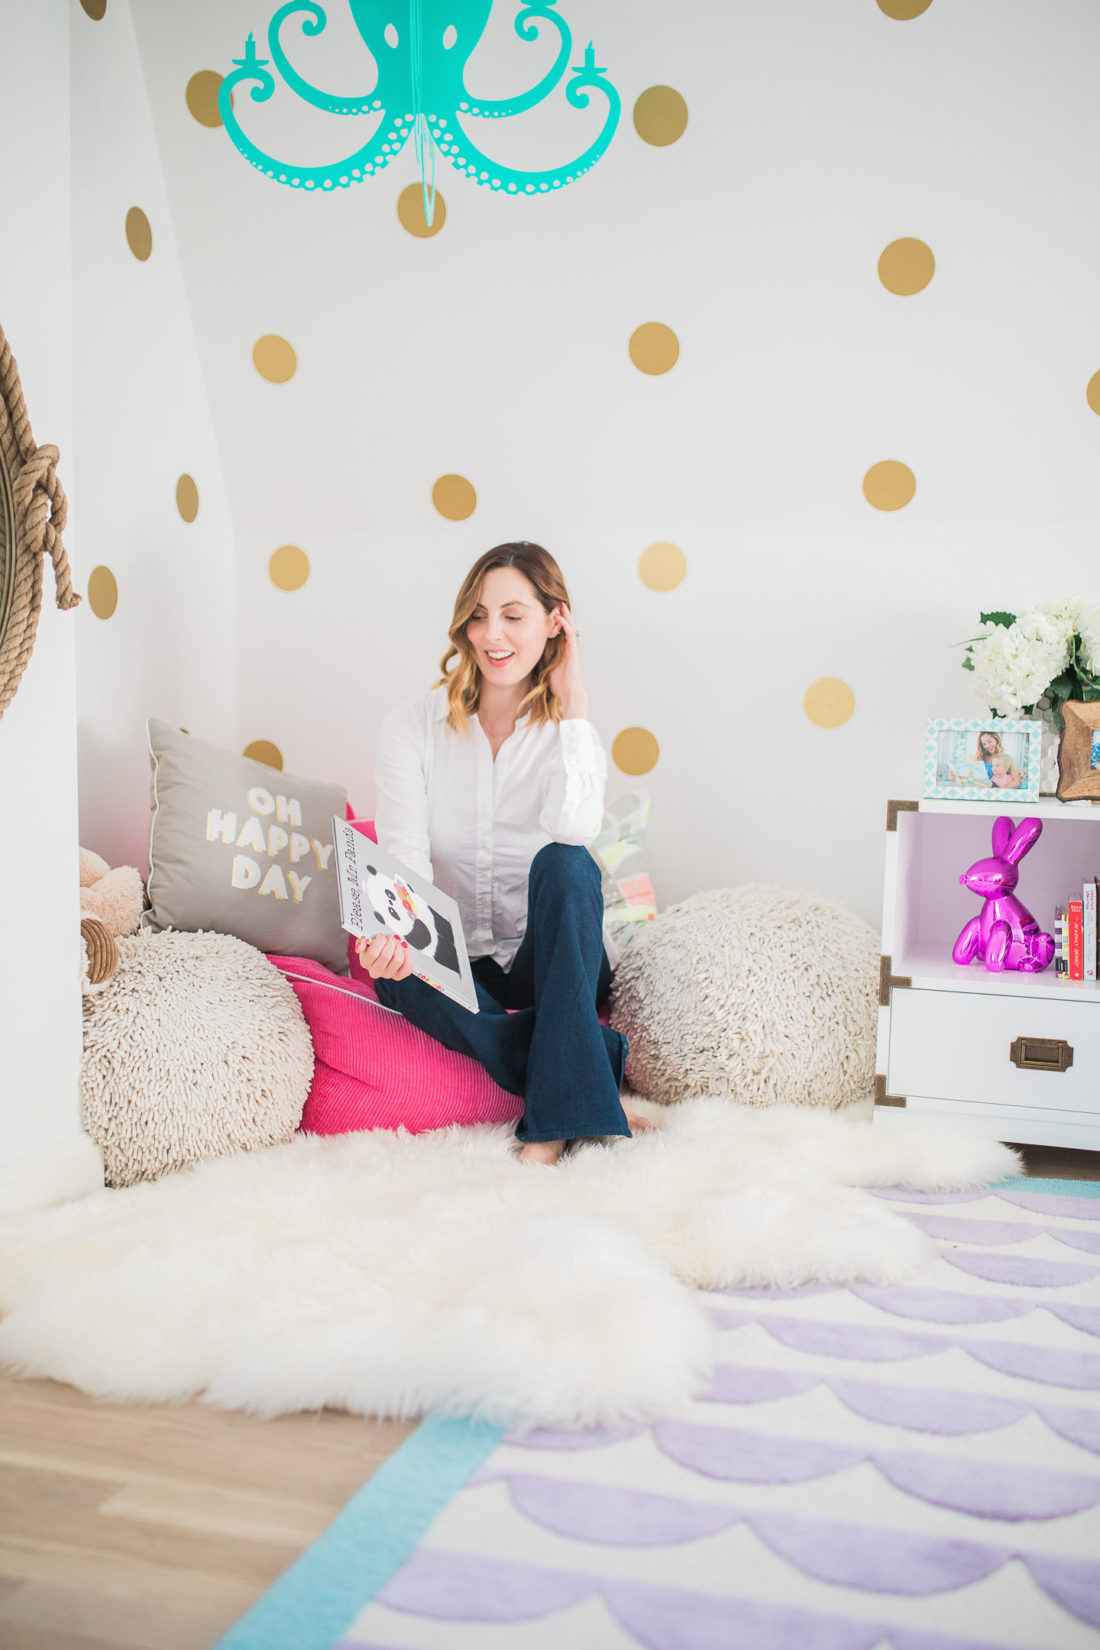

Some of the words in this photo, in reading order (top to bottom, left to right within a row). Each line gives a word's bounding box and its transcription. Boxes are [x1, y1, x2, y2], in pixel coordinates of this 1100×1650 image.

[247, 787, 302, 826] OH
[206, 808, 333, 871] HAPPY
[342, 827, 357, 865] Panda
[231, 854, 312, 904] DAY
